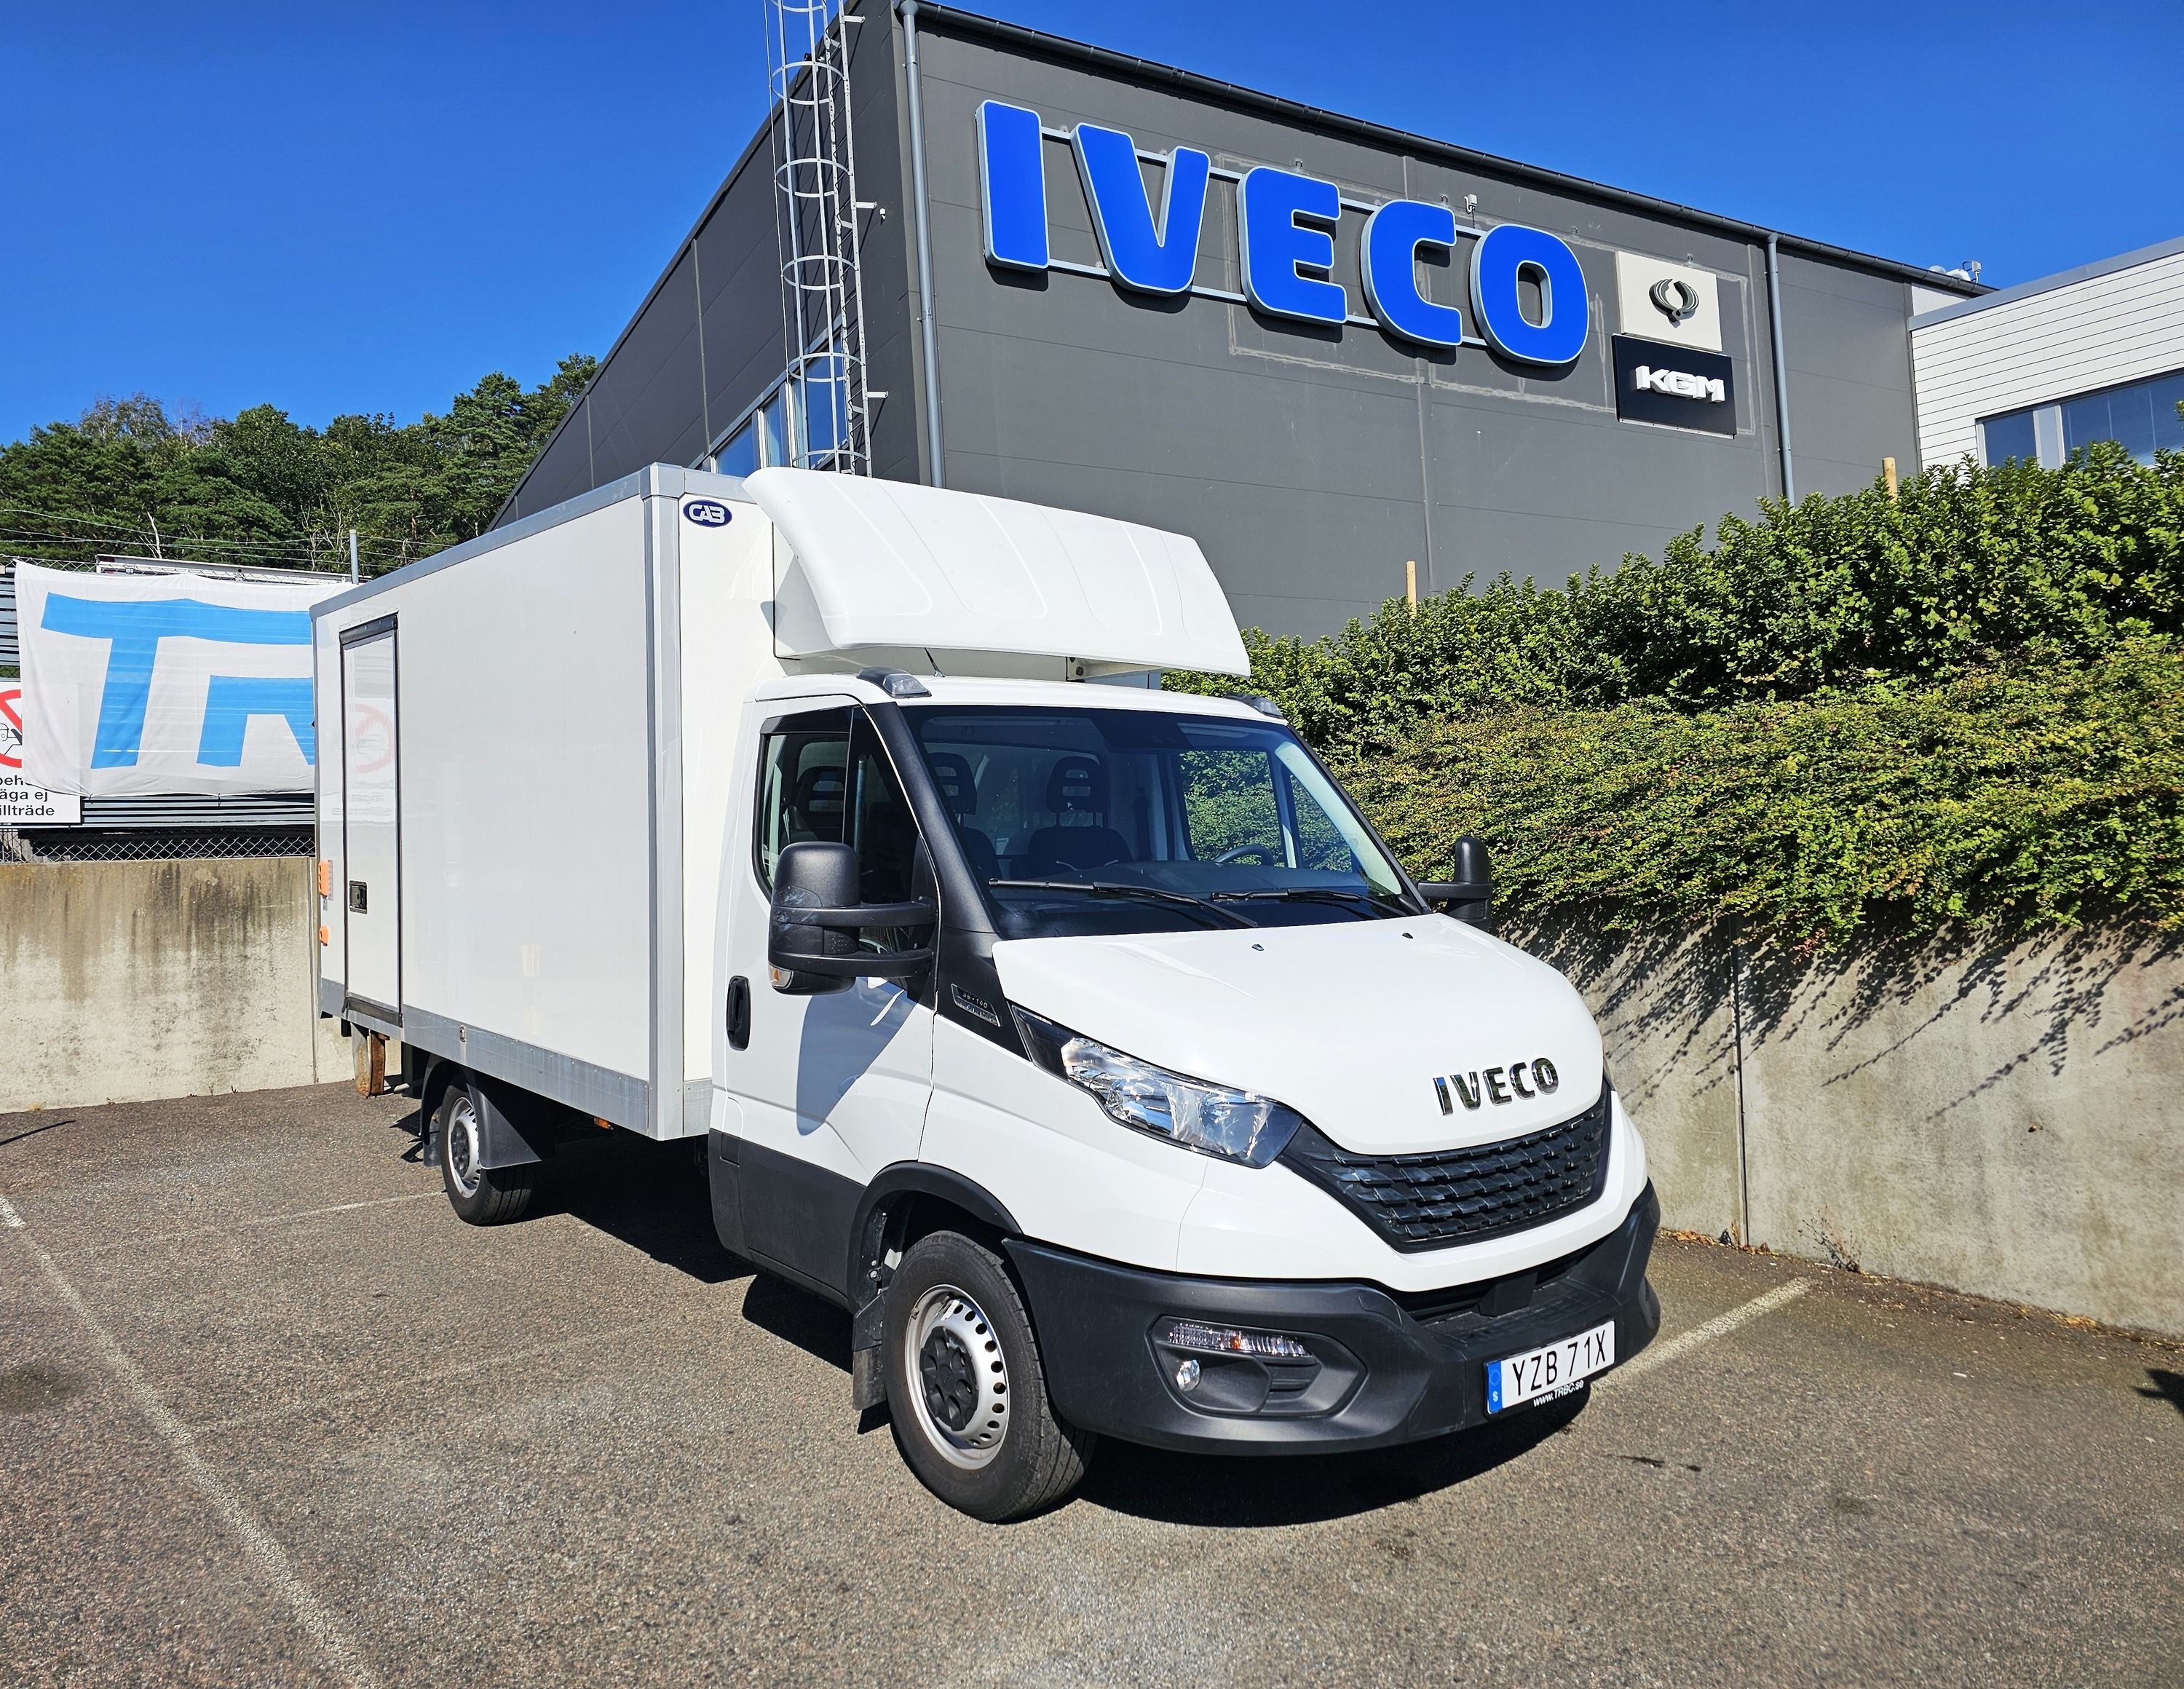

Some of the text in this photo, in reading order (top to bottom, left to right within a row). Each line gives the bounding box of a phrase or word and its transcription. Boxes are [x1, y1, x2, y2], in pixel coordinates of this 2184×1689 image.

[976, 100, 1590, 365] IVECO
[1636, 365, 1725, 403] KGM
[689, 504, 726, 523] CAB
[0, 804, 55, 816] illträde
[34, 791, 48, 802] ej
[1433, 1057, 1559, 1116] IVECO
[1512, 1329, 1606, 1396] YZB 71X
[1492, 1391, 1498, 1402] S
